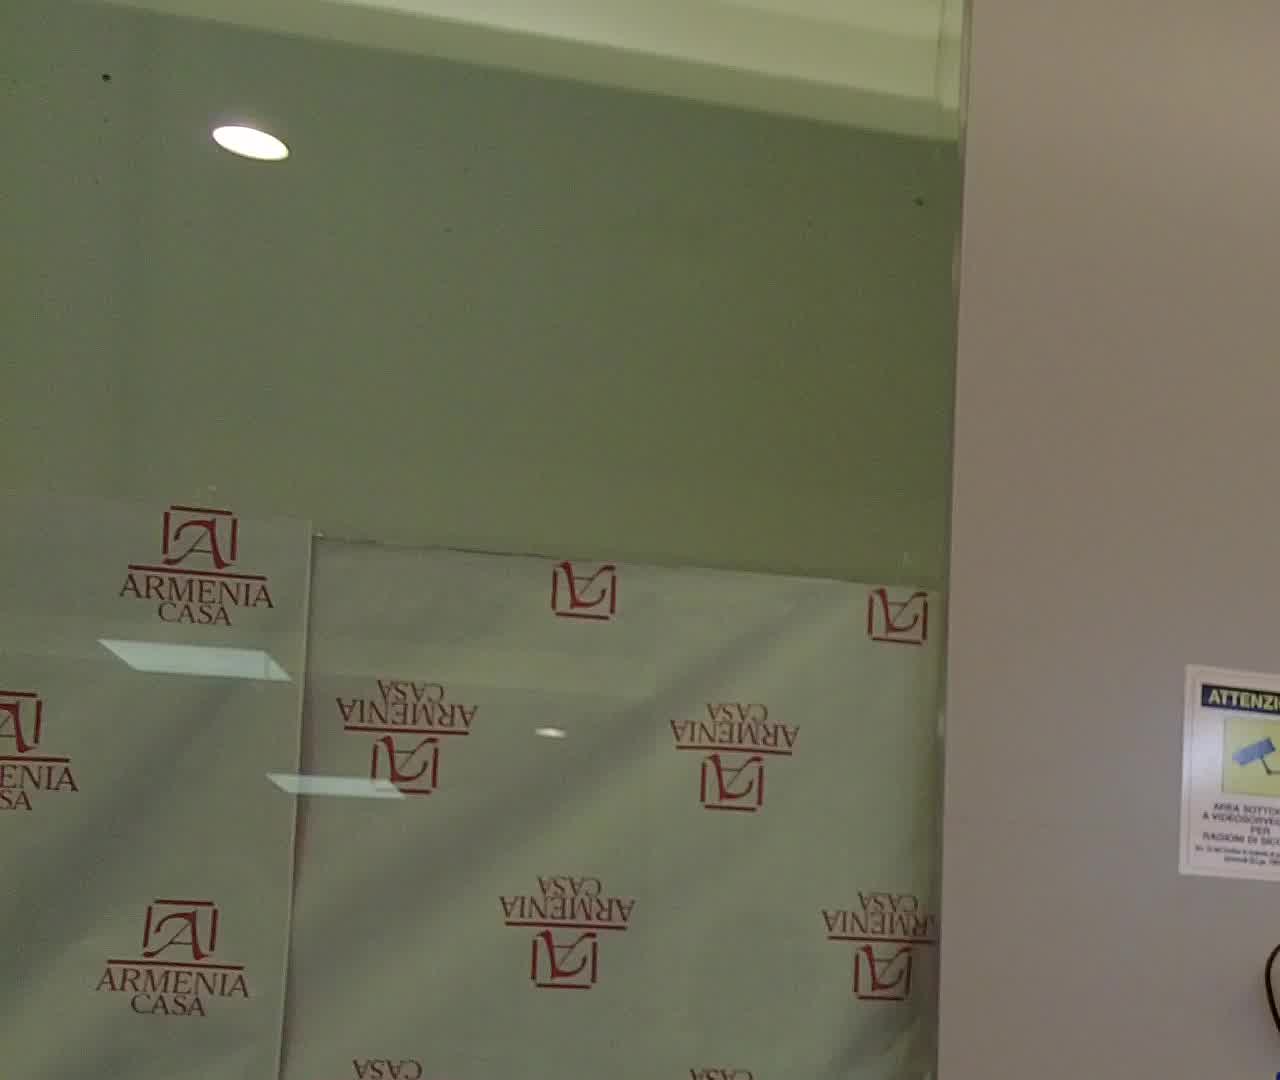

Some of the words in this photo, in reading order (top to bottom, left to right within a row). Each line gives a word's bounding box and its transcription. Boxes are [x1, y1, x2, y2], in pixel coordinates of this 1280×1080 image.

[119, 574, 274, 608] ARMENIA
[157, 602, 232, 626] CASA
[377, 680, 444, 704] CASA
[336, 697, 478, 728] ARMENIA
[706, 703, 768, 722] CASA
[670, 719, 800, 748] ARMENIA
[536, 875, 602, 897] CASA
[498, 894, 637, 922] ARMENIA
[857, 890, 919, 913] CASA
[821, 909, 935, 936] RMENIA
[96, 967, 249, 998] ARMENIA
[131, 993, 206, 1017] CASA
